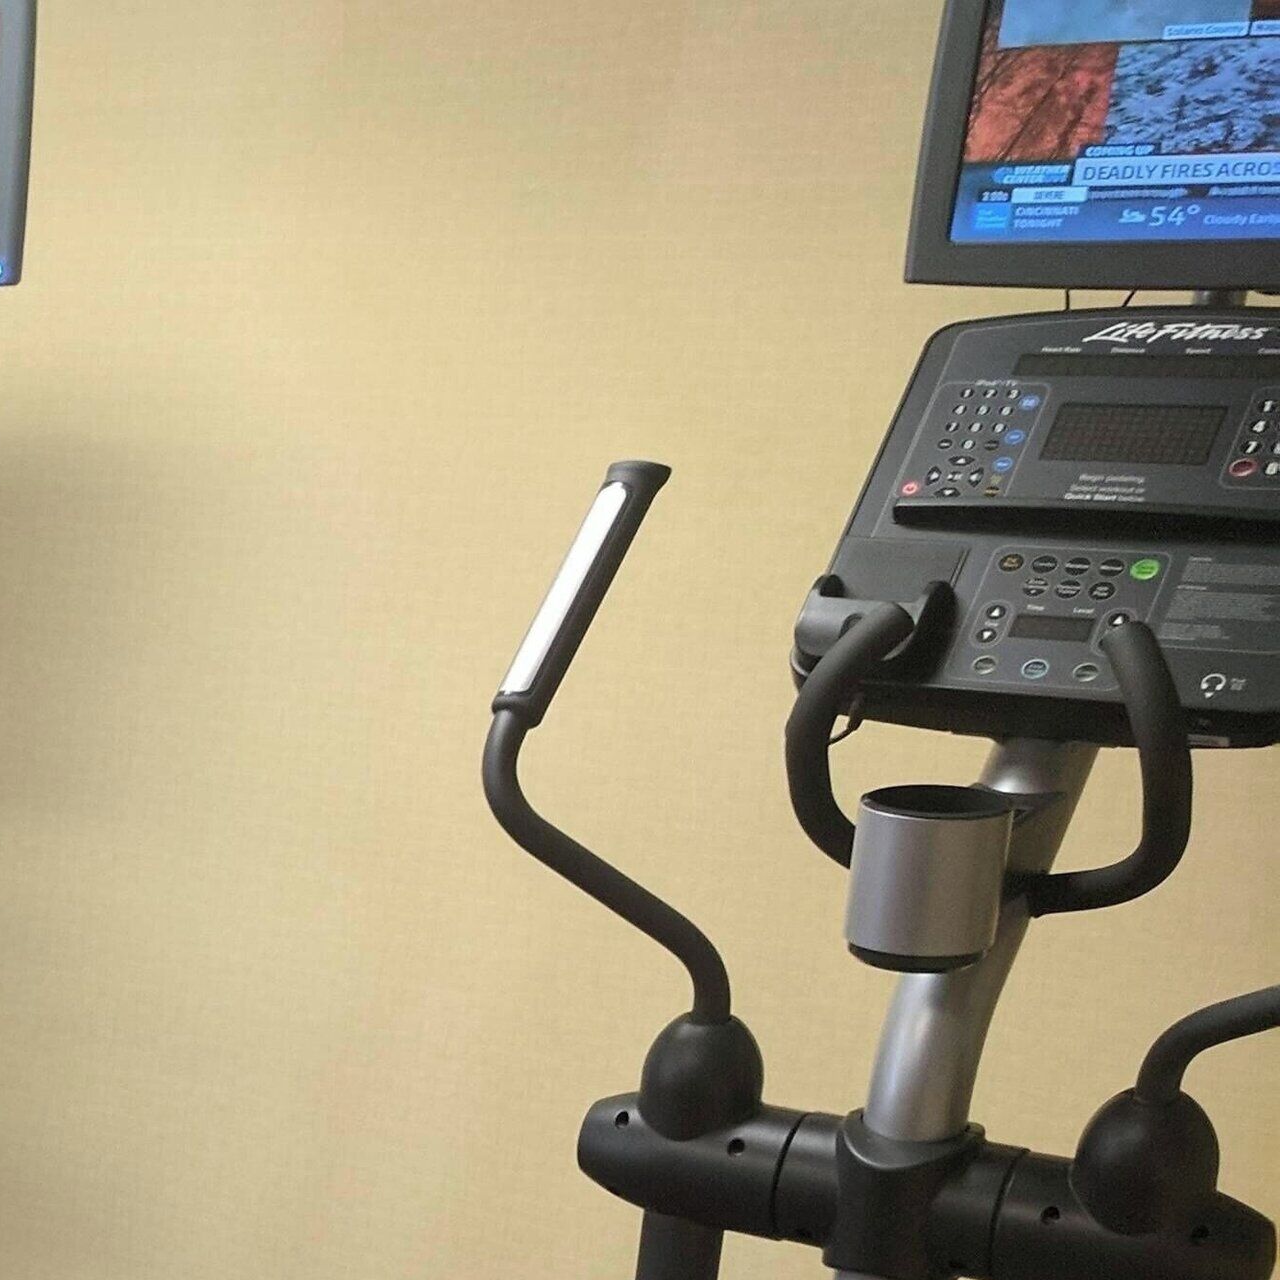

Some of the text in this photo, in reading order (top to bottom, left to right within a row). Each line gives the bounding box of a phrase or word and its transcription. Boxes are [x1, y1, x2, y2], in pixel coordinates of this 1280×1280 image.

[1083, 164, 1158, 181] DEADLY
[1160, 163, 1214, 179] FIRES
[1263, 400, 1273, 413] 1
[1245, 440, 1258, 454] 7
[1093, 493, 1117, 501] Start
